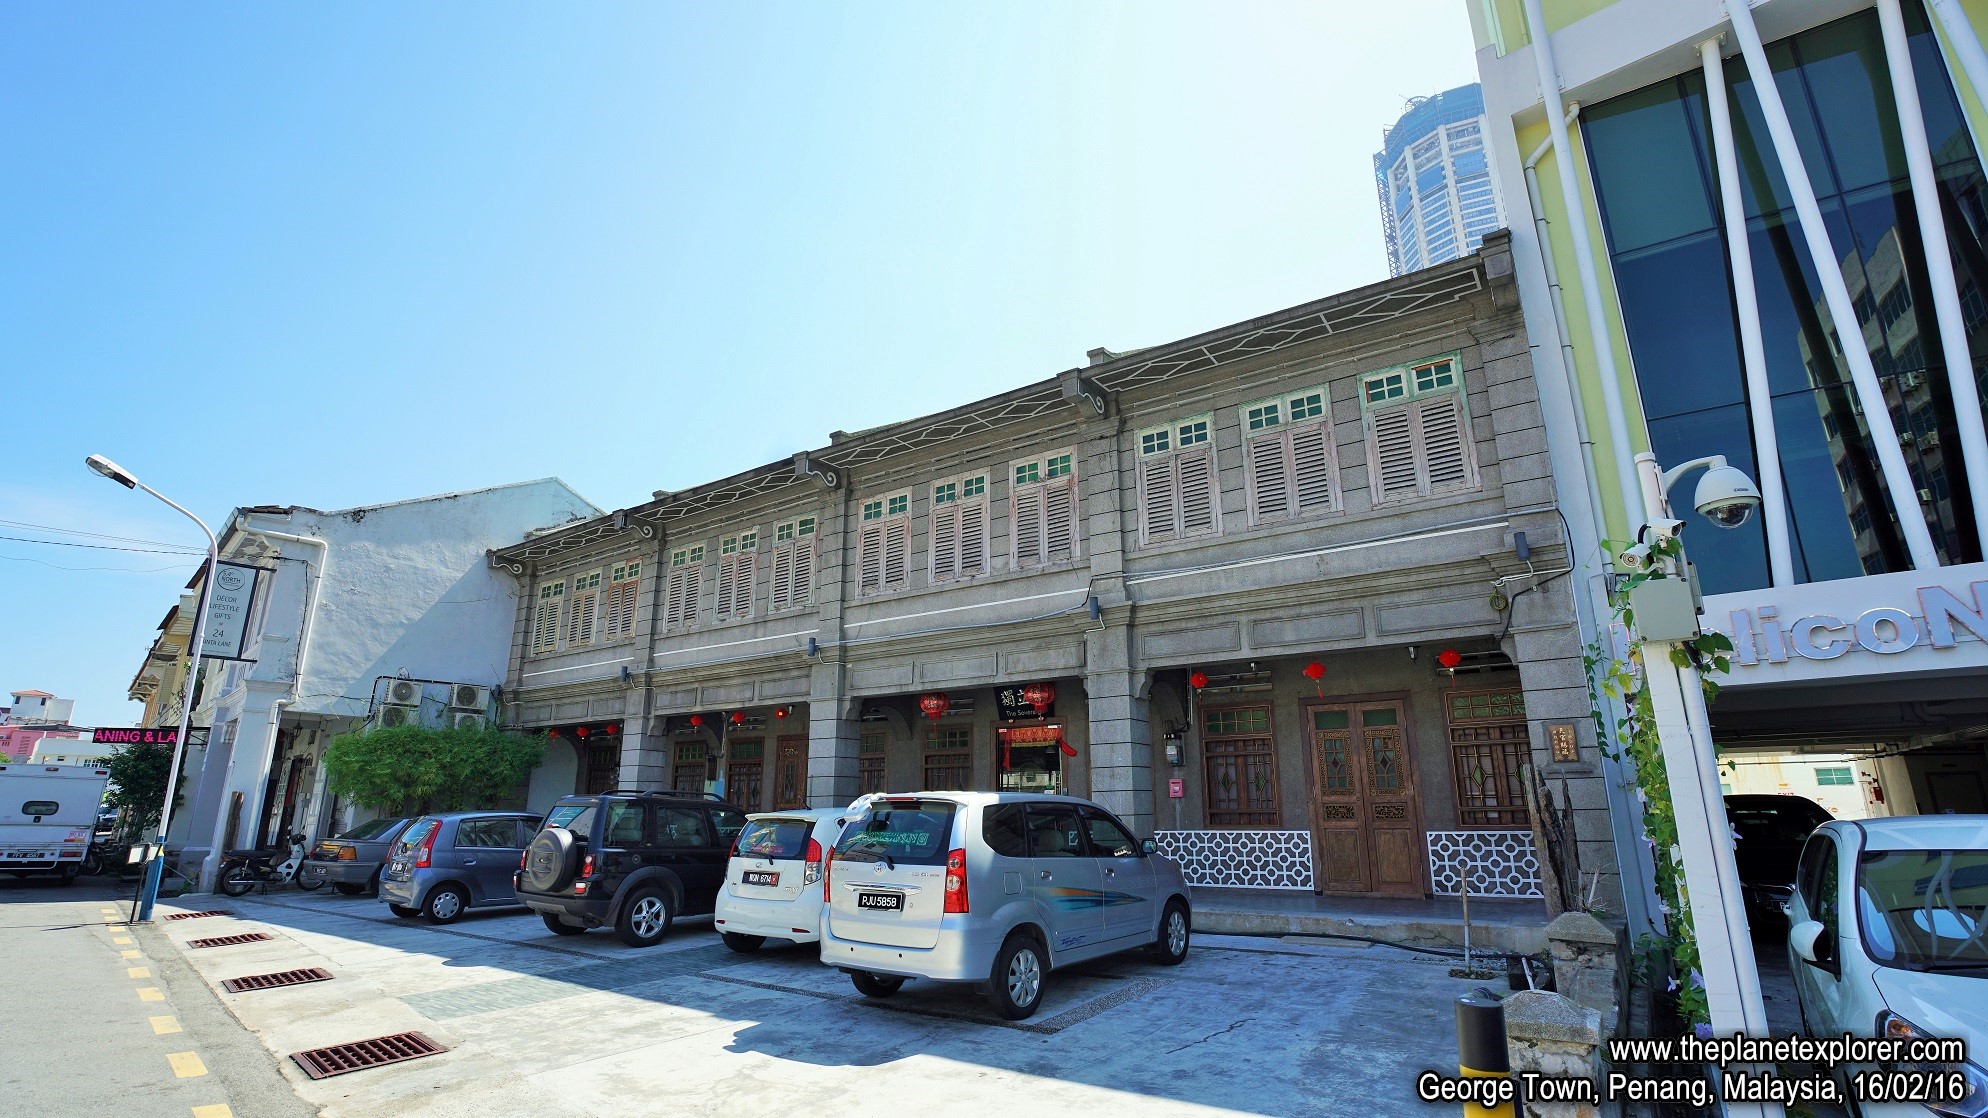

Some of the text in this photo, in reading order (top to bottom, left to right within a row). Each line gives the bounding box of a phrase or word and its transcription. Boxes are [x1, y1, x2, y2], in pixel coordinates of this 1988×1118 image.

[209, 603, 240, 613] LIFESTYLE
[214, 612, 231, 620] GIFTS
[212, 628, 224, 638] 24
[218, 640, 232, 648] LANE
[93, 729, 141, 743] ANING
[144, 731, 155, 743] &
[861, 895, 897, 907] PJU5858
